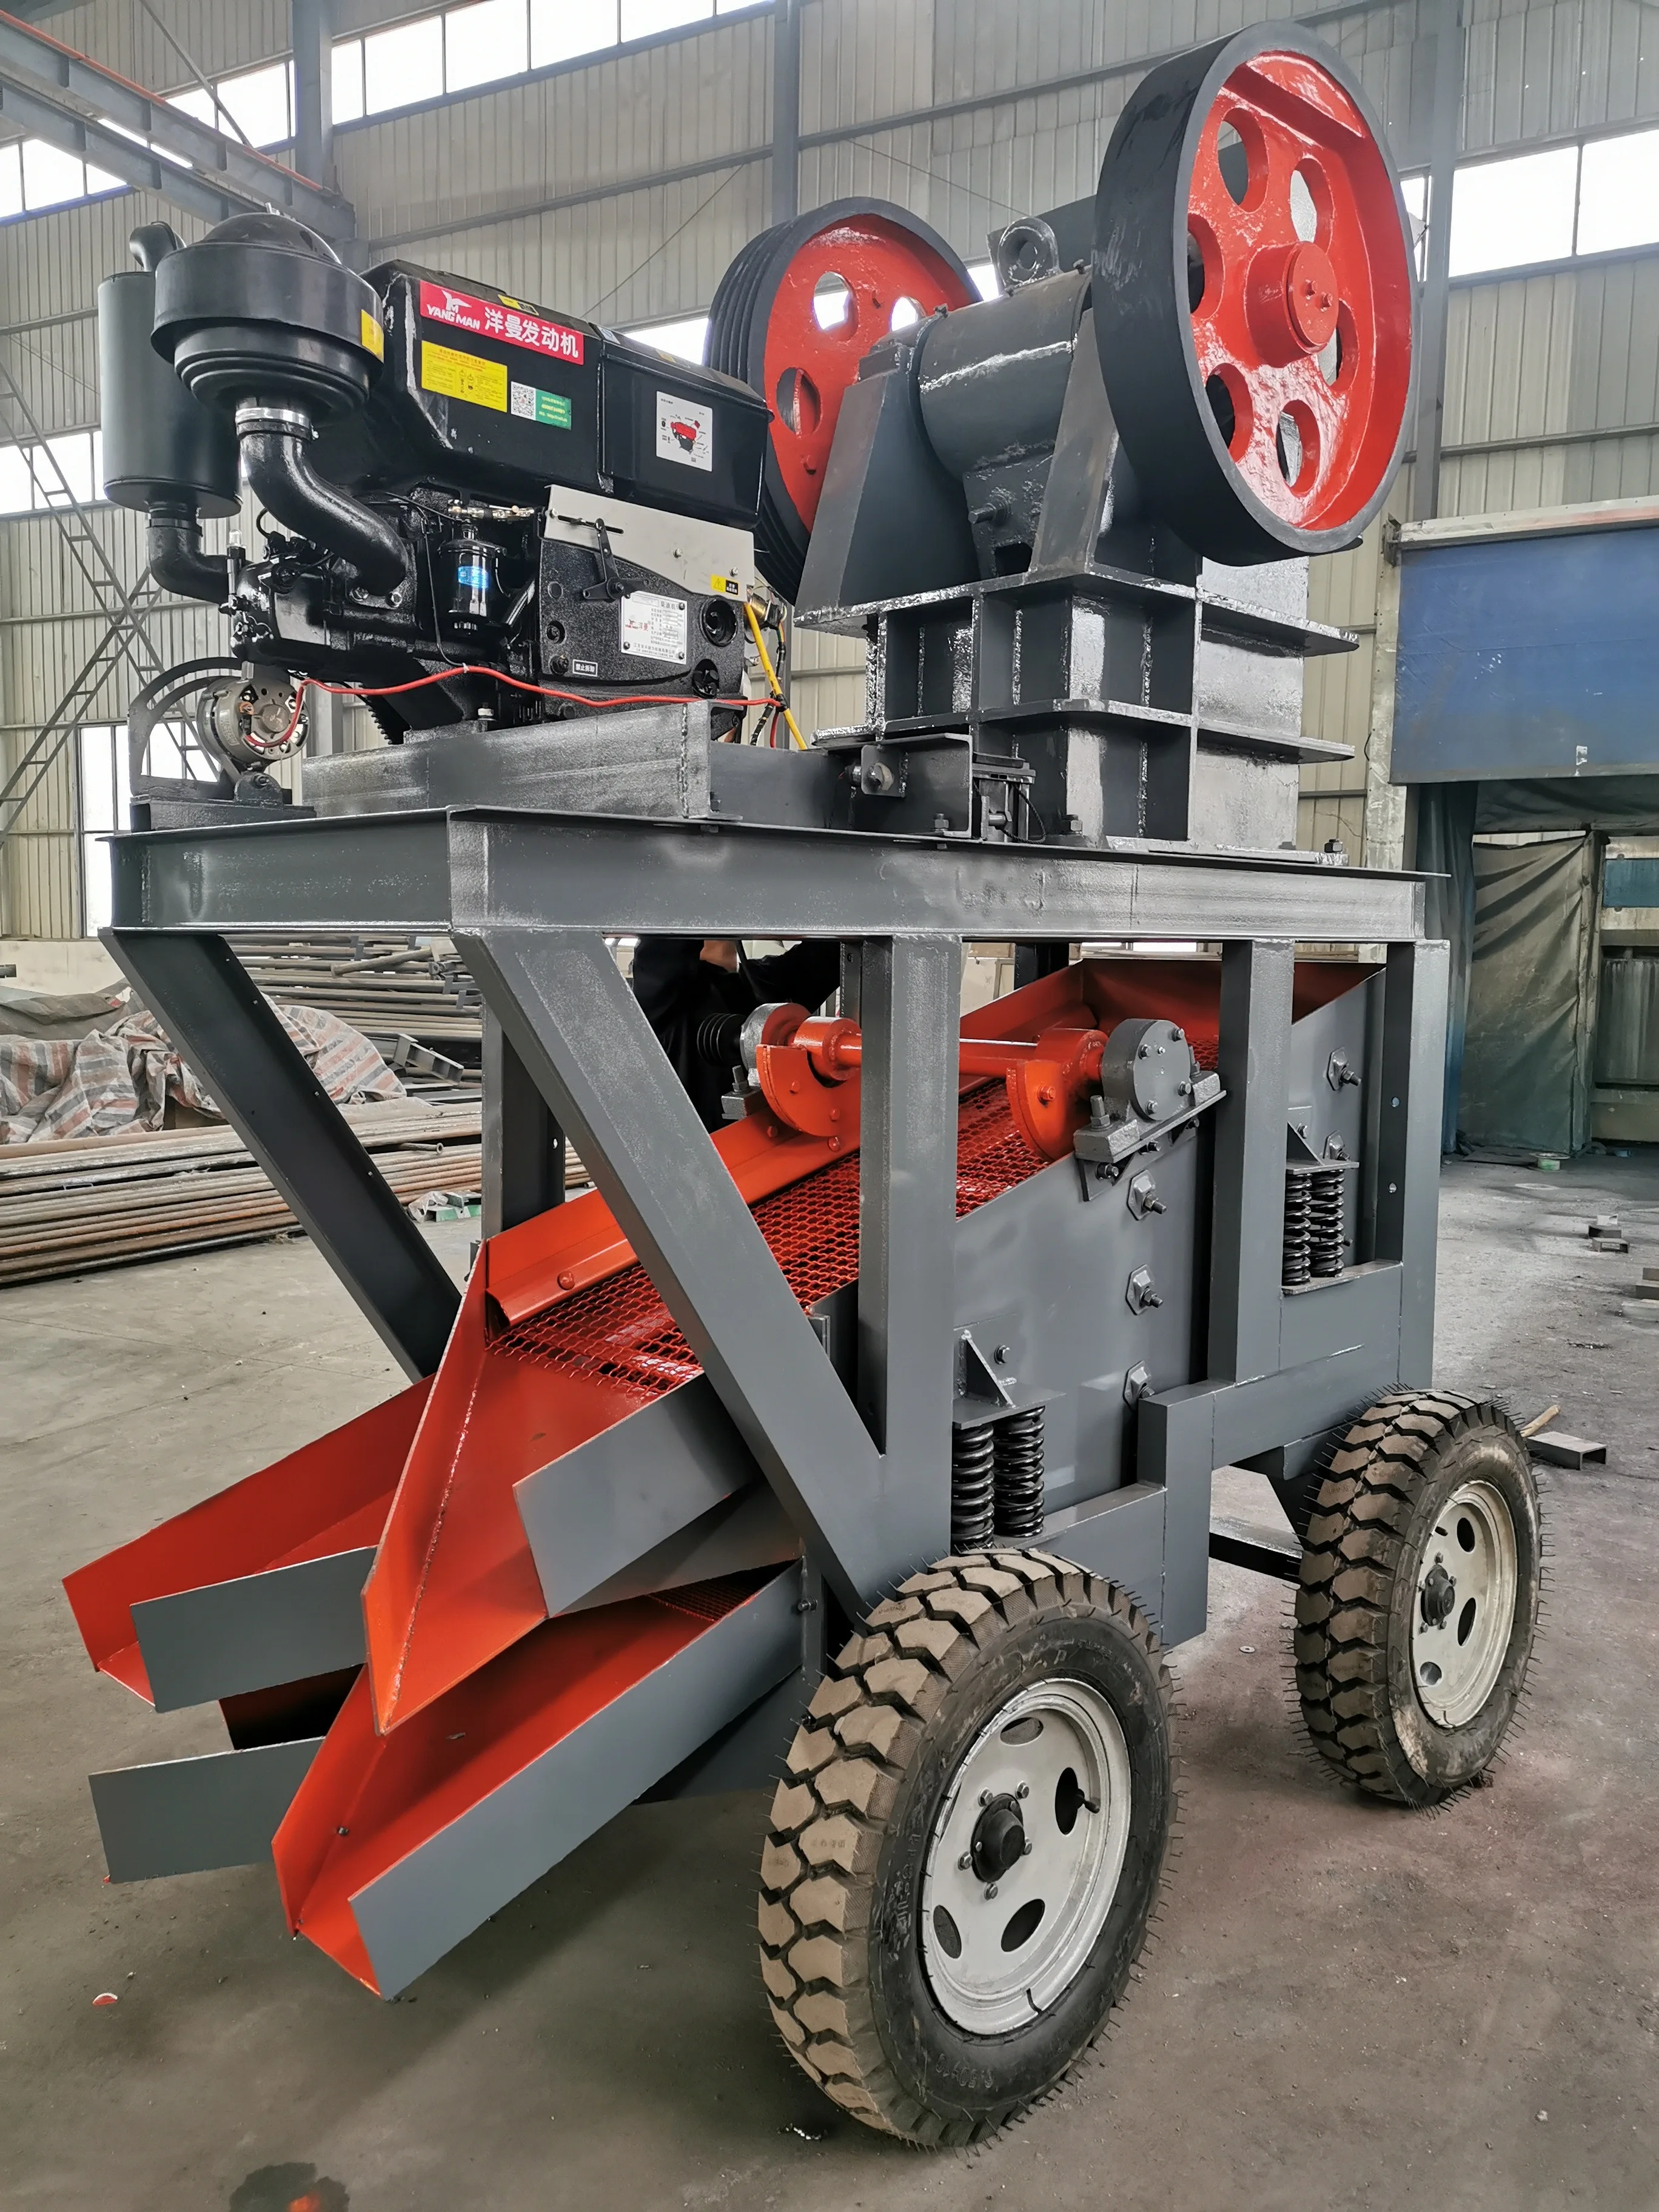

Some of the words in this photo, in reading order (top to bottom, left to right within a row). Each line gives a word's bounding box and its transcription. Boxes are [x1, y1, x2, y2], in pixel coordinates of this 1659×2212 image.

[426, 304, 455, 322] YANG
[455, 315, 481, 330] MAN
[484, 306, 579, 358] 洋曼发动机
